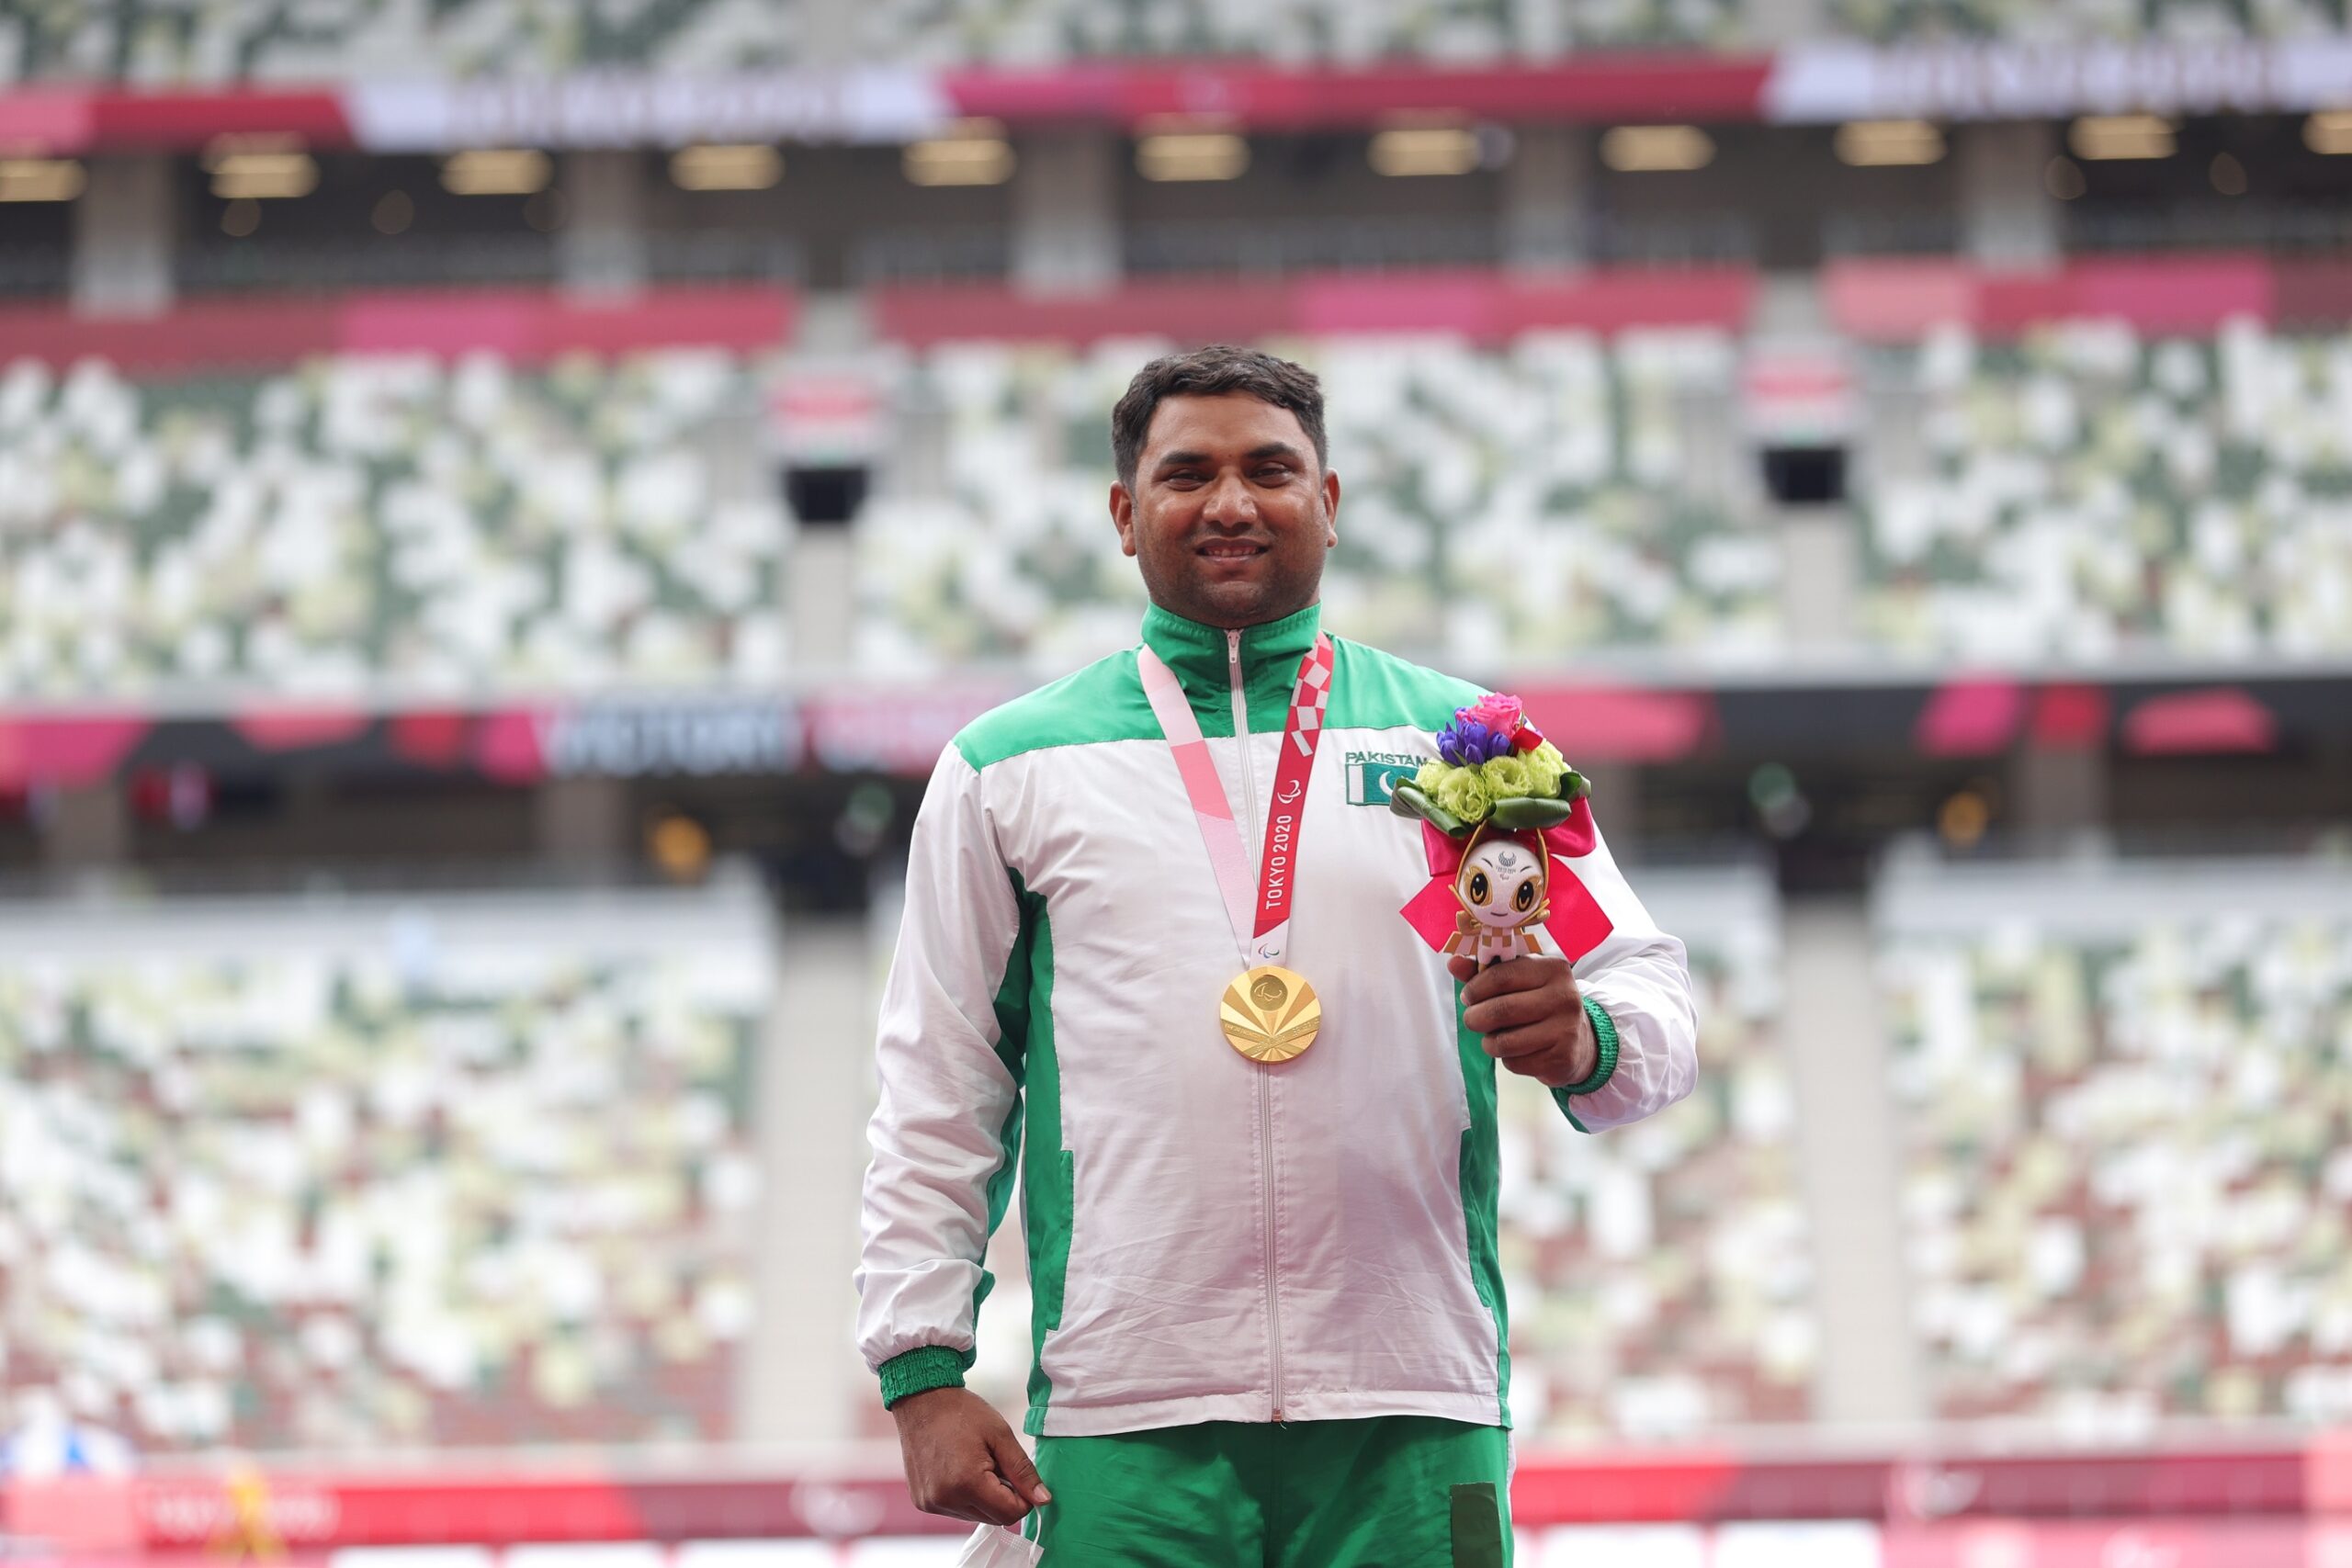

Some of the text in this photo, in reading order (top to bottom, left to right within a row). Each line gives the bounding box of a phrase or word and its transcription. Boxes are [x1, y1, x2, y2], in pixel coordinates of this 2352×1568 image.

[1345, 751, 1428, 766] PAKISTAN
[1265, 815, 1293, 910] TOKYO 2020
